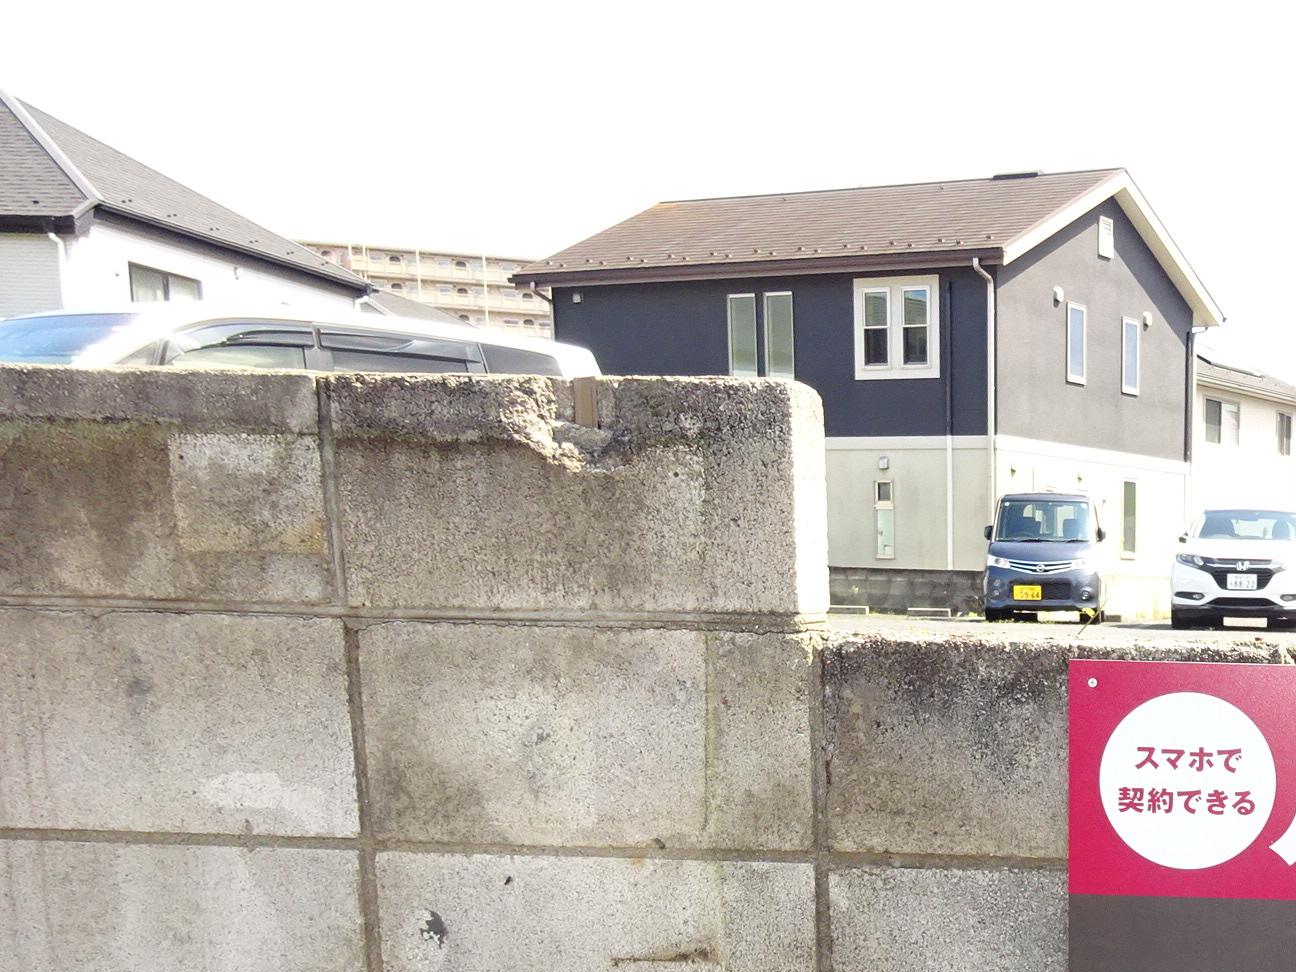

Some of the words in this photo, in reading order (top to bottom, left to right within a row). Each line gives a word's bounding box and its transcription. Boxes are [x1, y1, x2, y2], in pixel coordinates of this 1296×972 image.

[1135, 746, 1242, 773] スマホで
[1118, 787, 1256, 815] 契約できる
